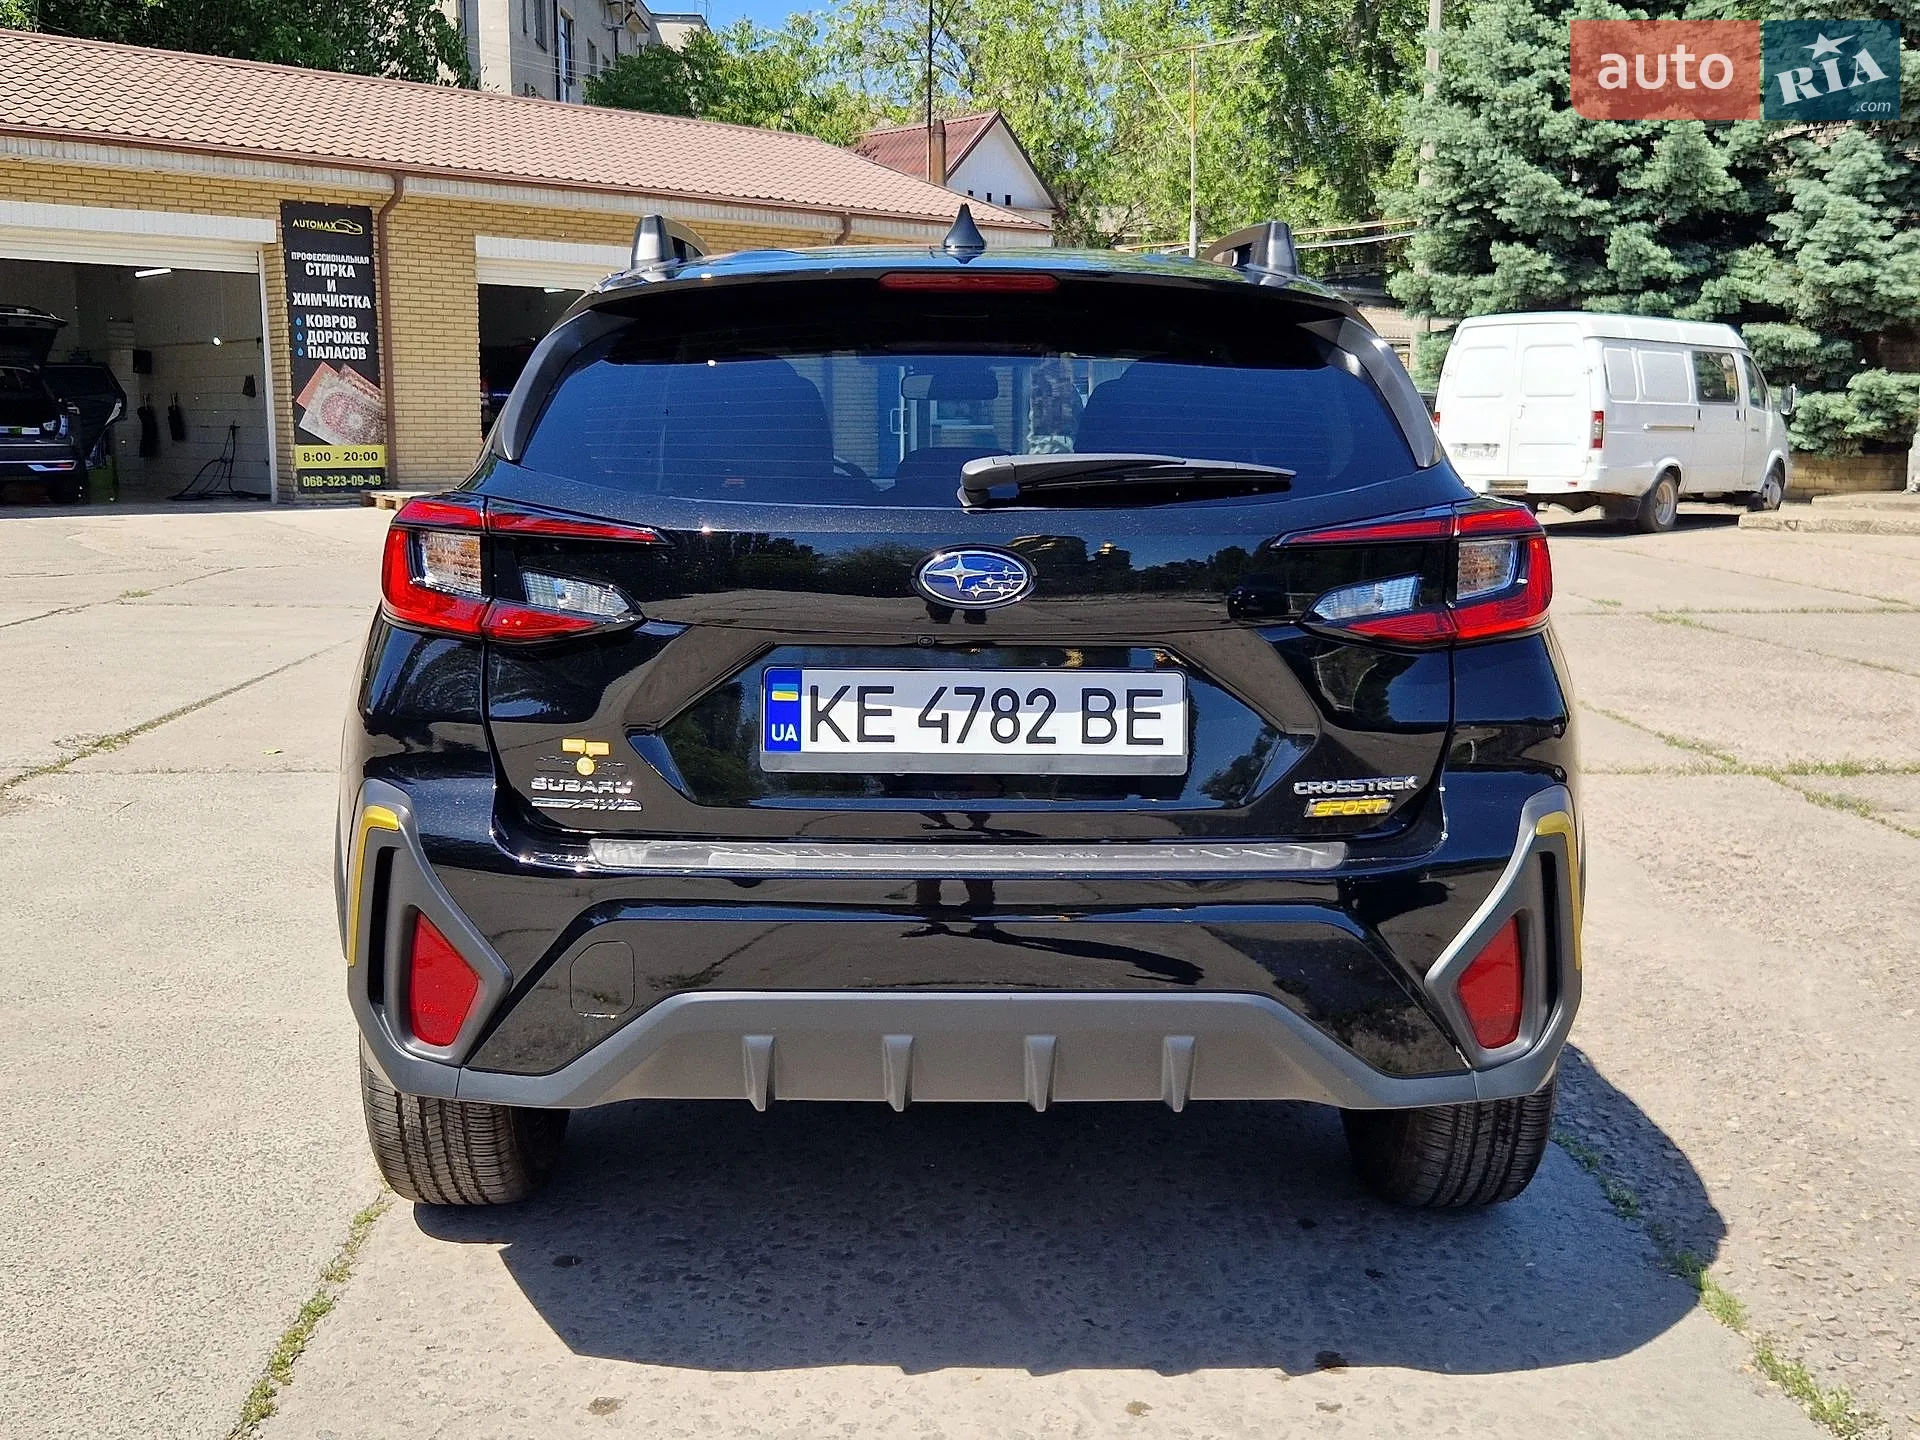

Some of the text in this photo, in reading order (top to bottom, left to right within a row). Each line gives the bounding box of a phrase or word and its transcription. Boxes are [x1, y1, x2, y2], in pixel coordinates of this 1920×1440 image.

[292, 219, 337, 230] AUTOMAX
[291, 251, 370, 265] ПРОФЕССИОНАЛЬНАЯ
[305, 262, 356, 278] СТИРКА
[326, 279, 337, 293] И
[292, 292, 372, 309] ХИМЧИСТКА
[305, 314, 357, 329] КОВРОВ
[306, 330, 370, 346] ДОРОЖЕК
[307, 346, 367, 360] ПАЛАСОВ
[303, 452, 331, 462] 8:00
[343, 451, 378, 461] 20:00
[302, 475, 381, 487] 068-323-09-49
[809, 685, 1164, 746] KE 4782 BE
[771, 723, 798, 742] UA
[530, 777, 634, 794] SUBARU
[1293, 775, 1419, 795] CROSSTREK
[1312, 798, 1390, 817] SPORT
